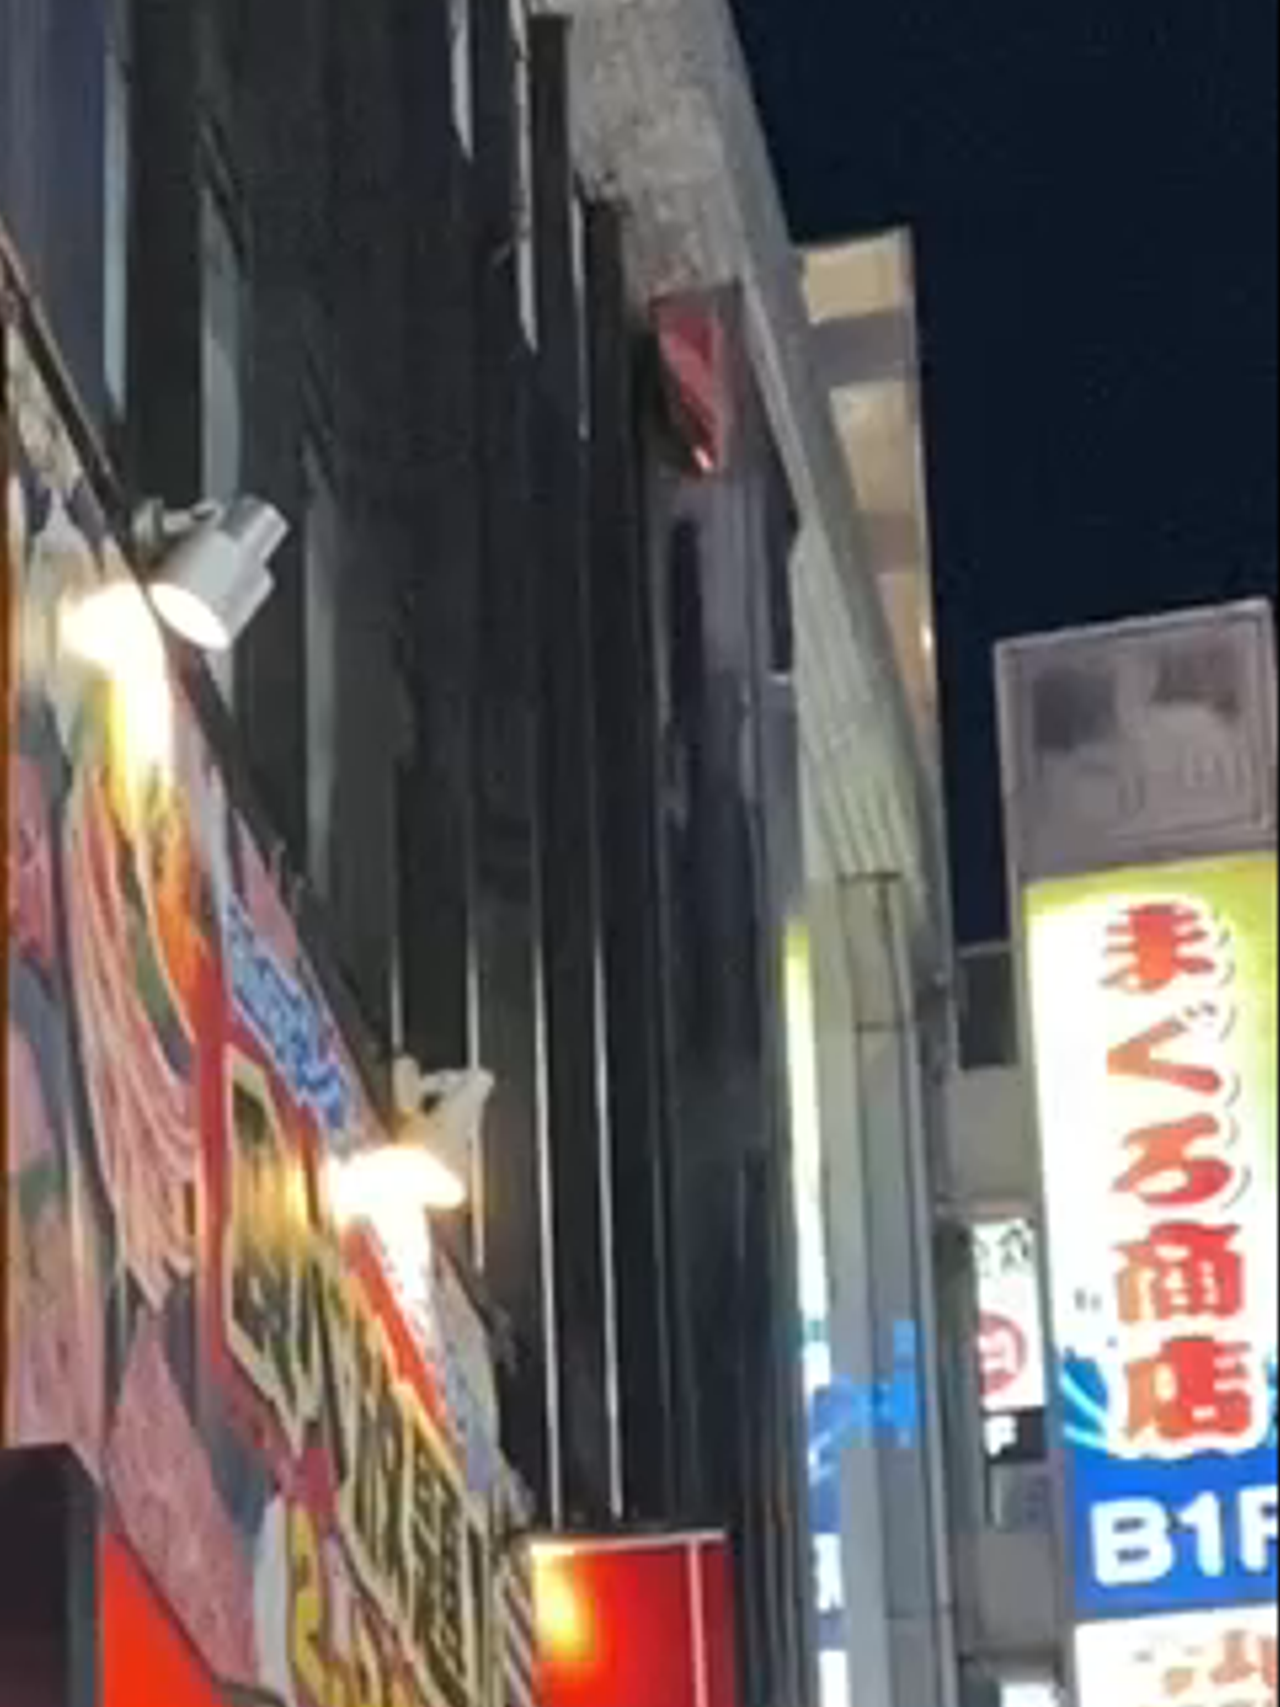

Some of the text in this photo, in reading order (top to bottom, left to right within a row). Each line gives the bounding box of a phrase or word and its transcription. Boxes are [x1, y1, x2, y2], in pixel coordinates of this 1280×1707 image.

[1100, 899, 1252, 1443] まぐろ商店
[1092, 1483, 1278, 1586] B1F
